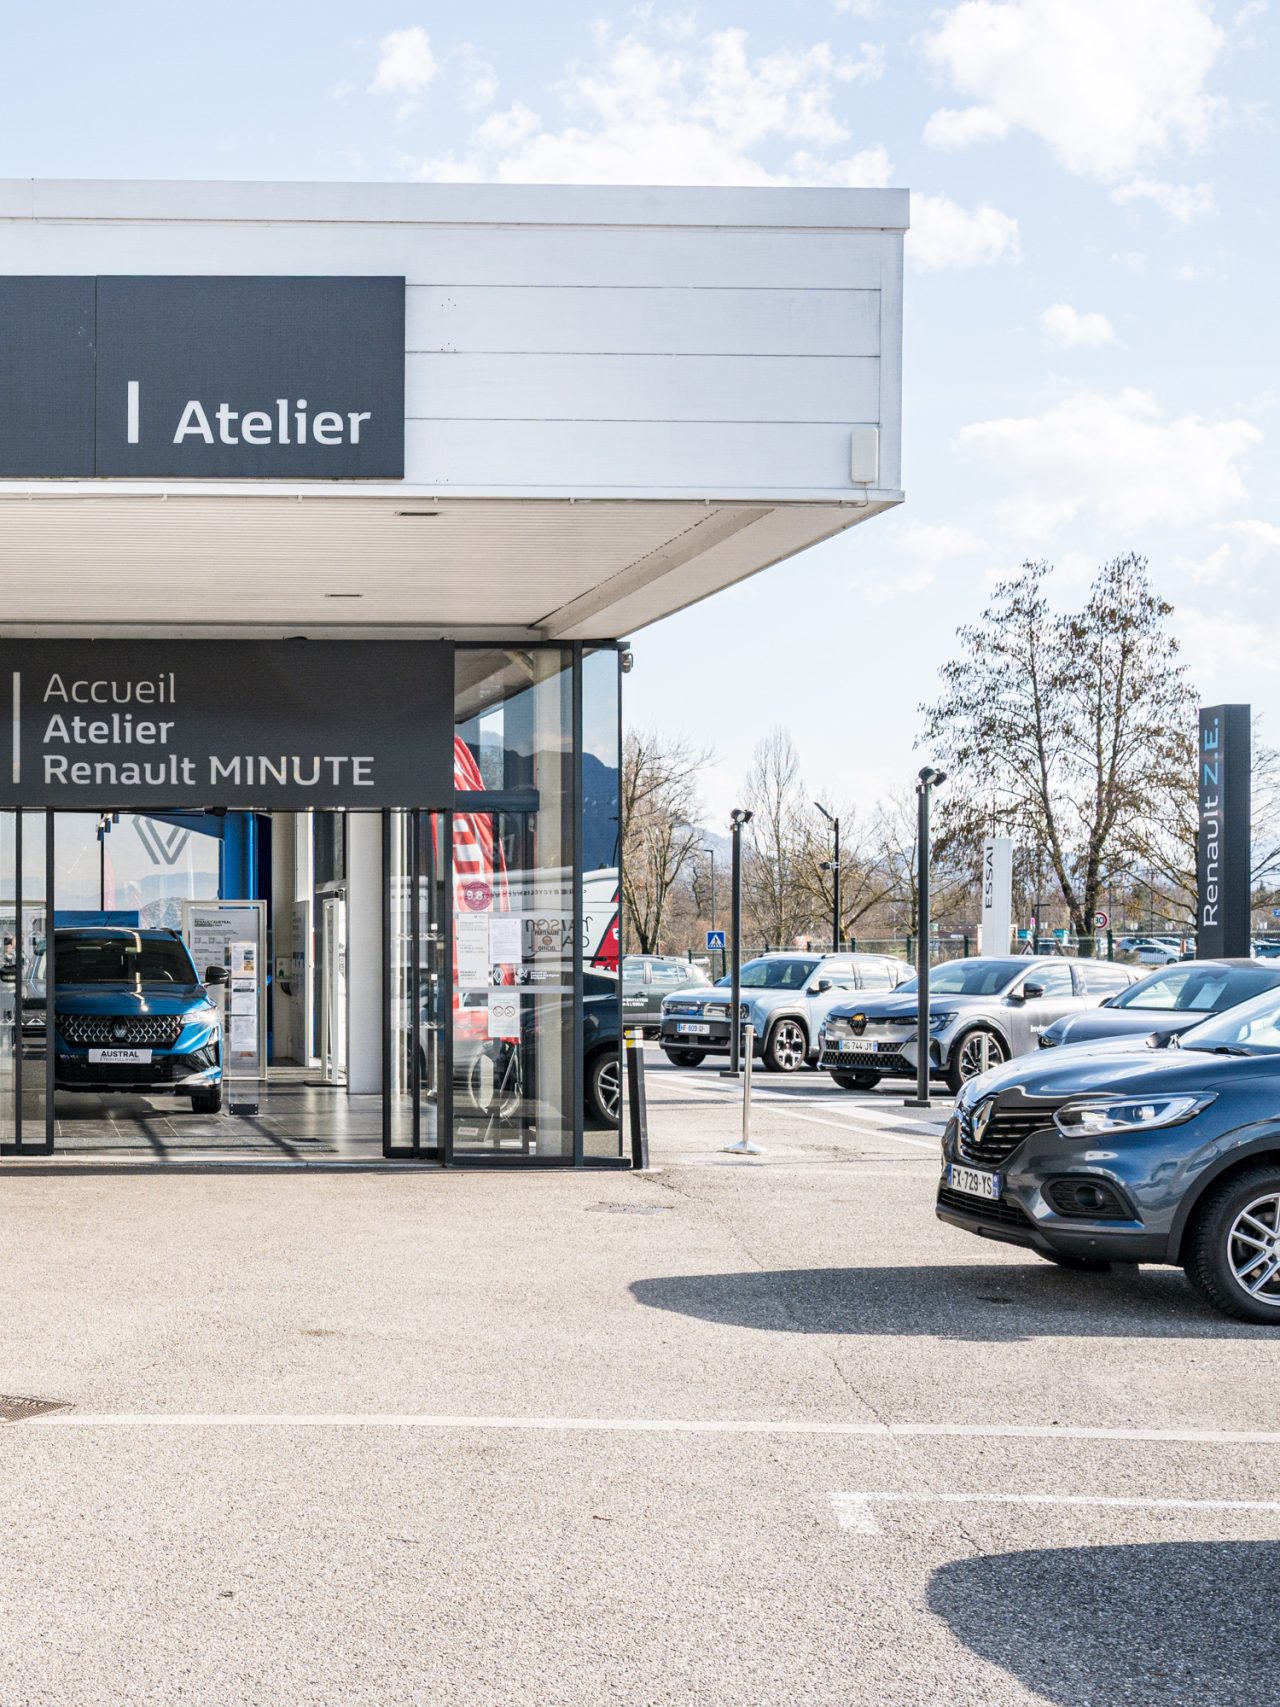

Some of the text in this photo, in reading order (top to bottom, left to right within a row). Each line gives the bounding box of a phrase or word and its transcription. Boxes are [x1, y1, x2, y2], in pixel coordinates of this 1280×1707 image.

[172, 398, 372, 446] Atelier
[43, 673, 176, 703] Accueil
[43, 713, 175, 744] Atelier
[43, 754, 375, 787] Renault MINUTE
[1203, 717, 1220, 927] Renault Z.E.
[984, 845, 994, 909] ESSAI
[952, 1168, 993, 1195] FX-729-YS
